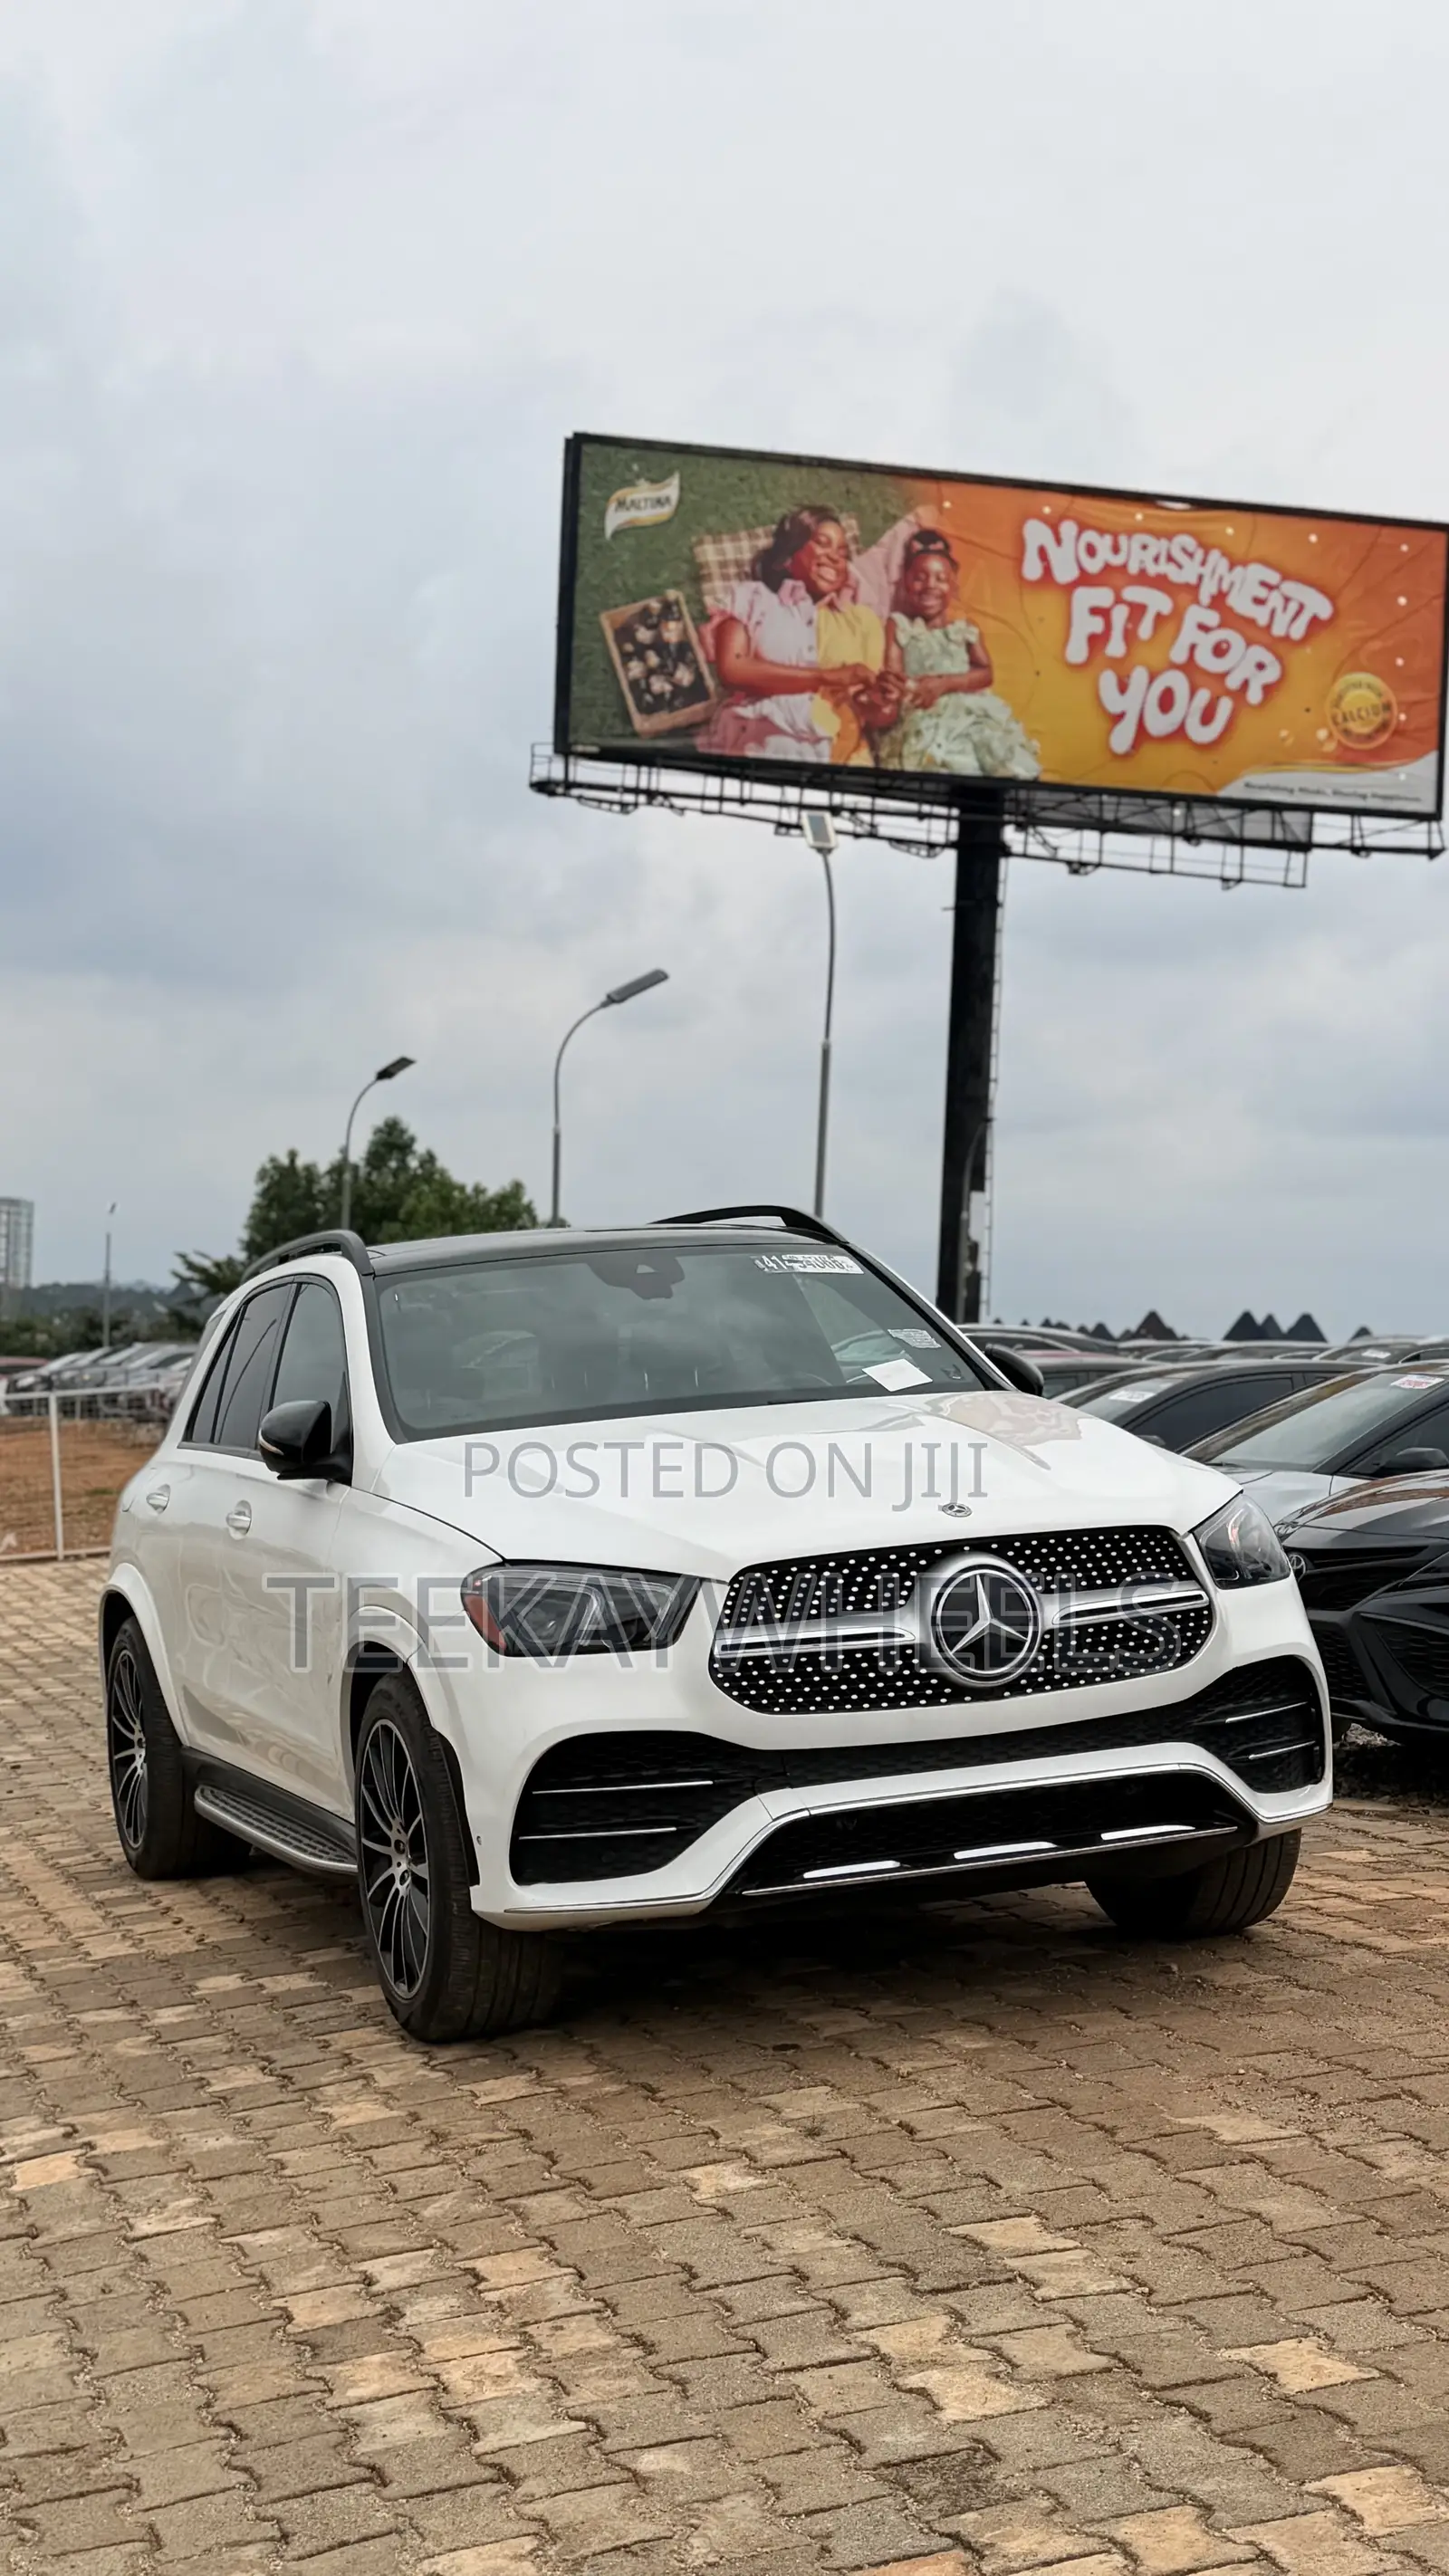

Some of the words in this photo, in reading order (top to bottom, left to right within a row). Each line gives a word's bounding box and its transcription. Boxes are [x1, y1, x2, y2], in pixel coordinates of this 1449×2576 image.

[1022, 518, 1333, 640] NOURISHMENT
[1065, 586, 1174, 664] FIT
[1169, 603, 1282, 705] FOR
[1099, 666, 1233, 754] YOU
